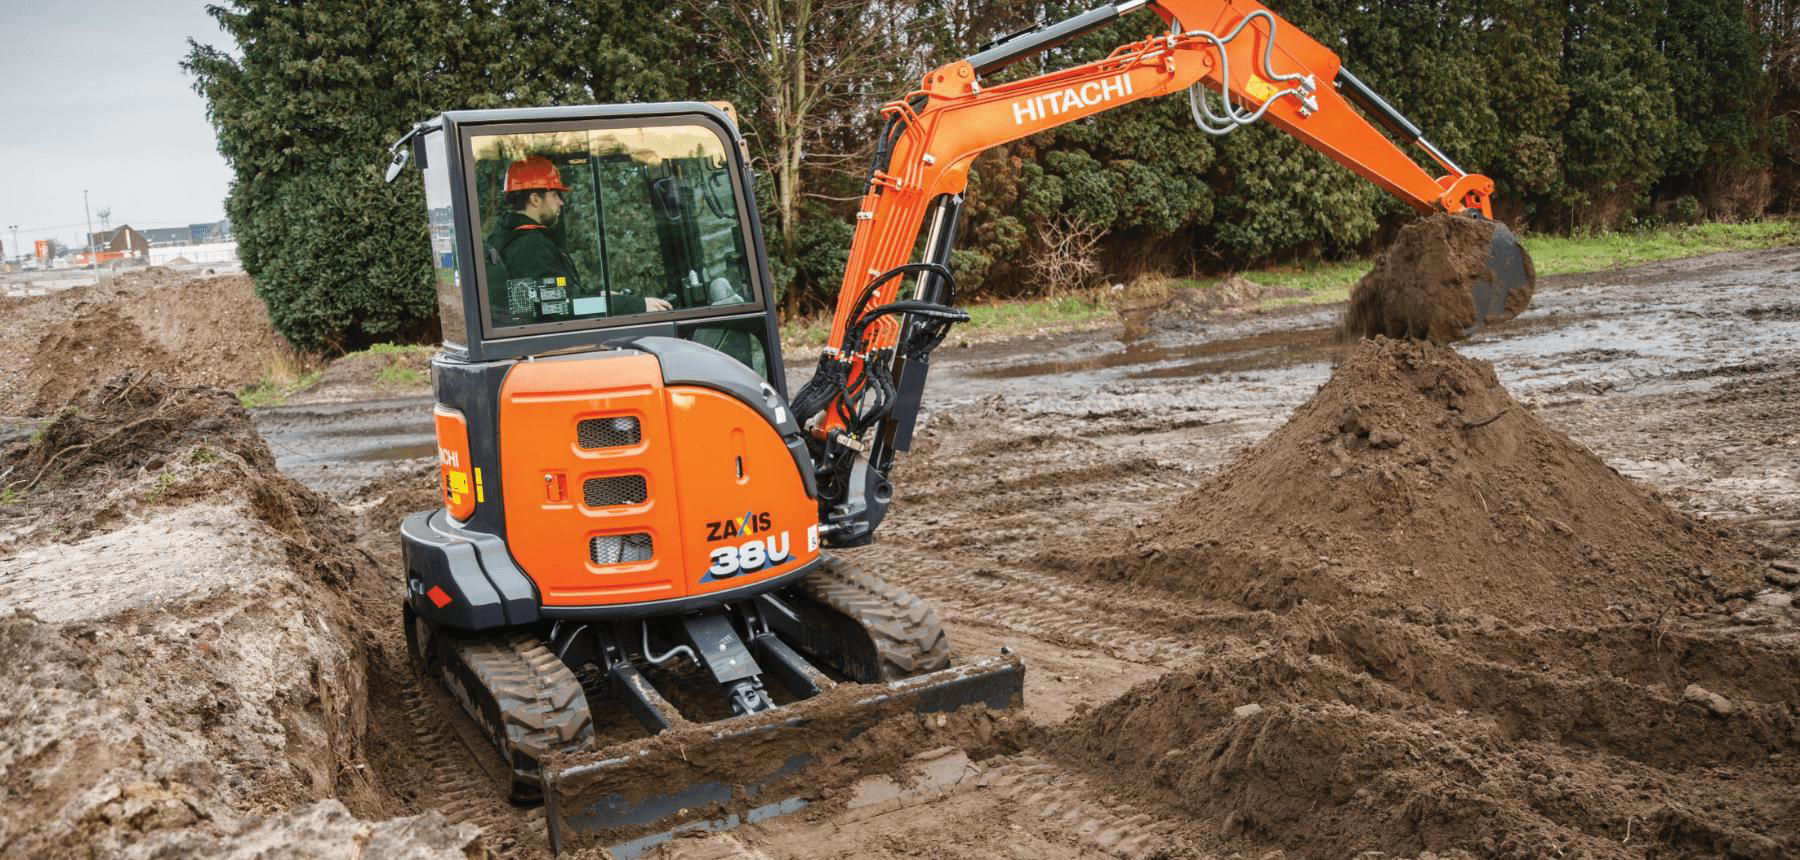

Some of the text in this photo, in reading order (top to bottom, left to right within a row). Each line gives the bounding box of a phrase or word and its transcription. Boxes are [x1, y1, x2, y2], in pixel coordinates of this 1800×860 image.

[1013, 72, 1133, 125] HITACHI
[706, 512, 771, 542] ZAXIS
[709, 531, 790, 579] 38U
